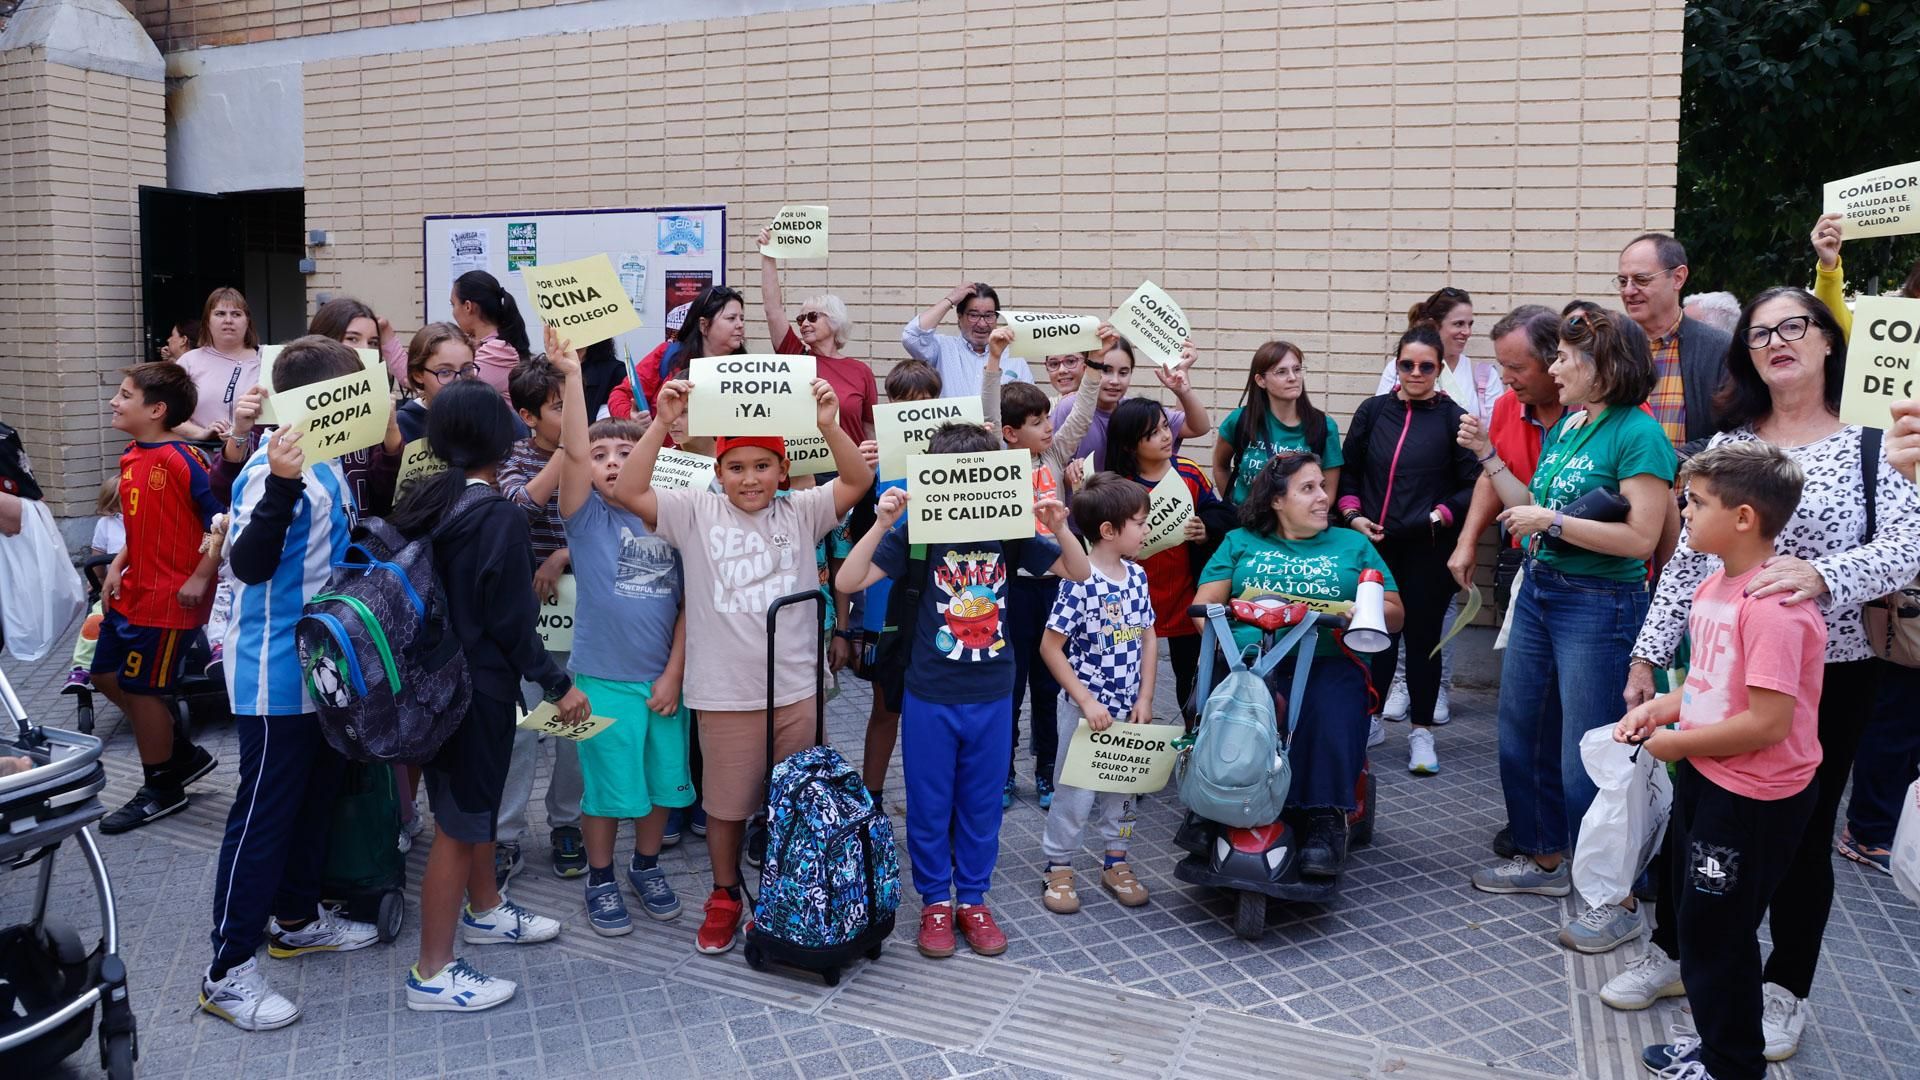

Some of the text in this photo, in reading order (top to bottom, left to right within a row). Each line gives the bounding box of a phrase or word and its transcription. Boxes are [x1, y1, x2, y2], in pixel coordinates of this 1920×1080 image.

[1839, 176, 1918, 199] COMEDOR
[1846, 207, 1886, 219] SEGURO
[1898, 204, 1911, 212] DE
[770, 220, 822, 231] OMEDOR
[1857, 215, 1900, 227] CALIDAD
[777, 235, 812, 245] DIGNO
[554, 276, 578, 287] UNA
[563, 303, 619, 326] COLEGIO
[1139, 294, 1190, 339] COMEDO
[1032, 323, 1081, 340] DIGNO
[1130, 319, 1142, 329] DE
[1130, 305, 1185, 353] CON PRODUCTOS
[716, 361, 791, 373] COCINA
[1873, 355, 1910, 370] CON
[720, 380, 792, 394] PROPIA
[1863, 374, 1895, 396] DE
[305, 379, 372, 411] COCINA
[309, 402, 372, 432] PROPIA
[897, 405, 962, 422] COCINA
[783, 436, 826, 447] ODUCTOS
[903, 427, 936, 443] PRO
[656, 454, 712, 470] COMEDOR
[786, 447, 829, 461] LIDAD
[651, 474, 673, 483] EGURO
[680, 479, 691, 488] DE
[918, 465, 1022, 485] COMEDOR
[130, 487, 140, 516] 9
[925, 490, 1017, 503] CON PRODUCTOS
[921, 504, 1023, 522] DE CALIDAD
[1147, 497, 1182, 531] CINA
[1149, 534, 1162, 545] MI
[1162, 503, 1193, 536] COLEGIO
[710, 525, 766, 560] SEA
[946, 550, 996, 562] Rocking
[719, 550, 773, 589] YOU
[936, 562, 1006, 585] RAMEN
[1256, 564, 1277, 574] DE
[615, 582, 653, 593] POWERFUL
[1113, 627, 1135, 645] PAW
[124, 650, 143, 677] 9
[1090, 732, 1166, 752] COMEDOR
[1091, 761, 1128, 773] SEGURO
[1098, 772, 1137, 783] CALIDAD
